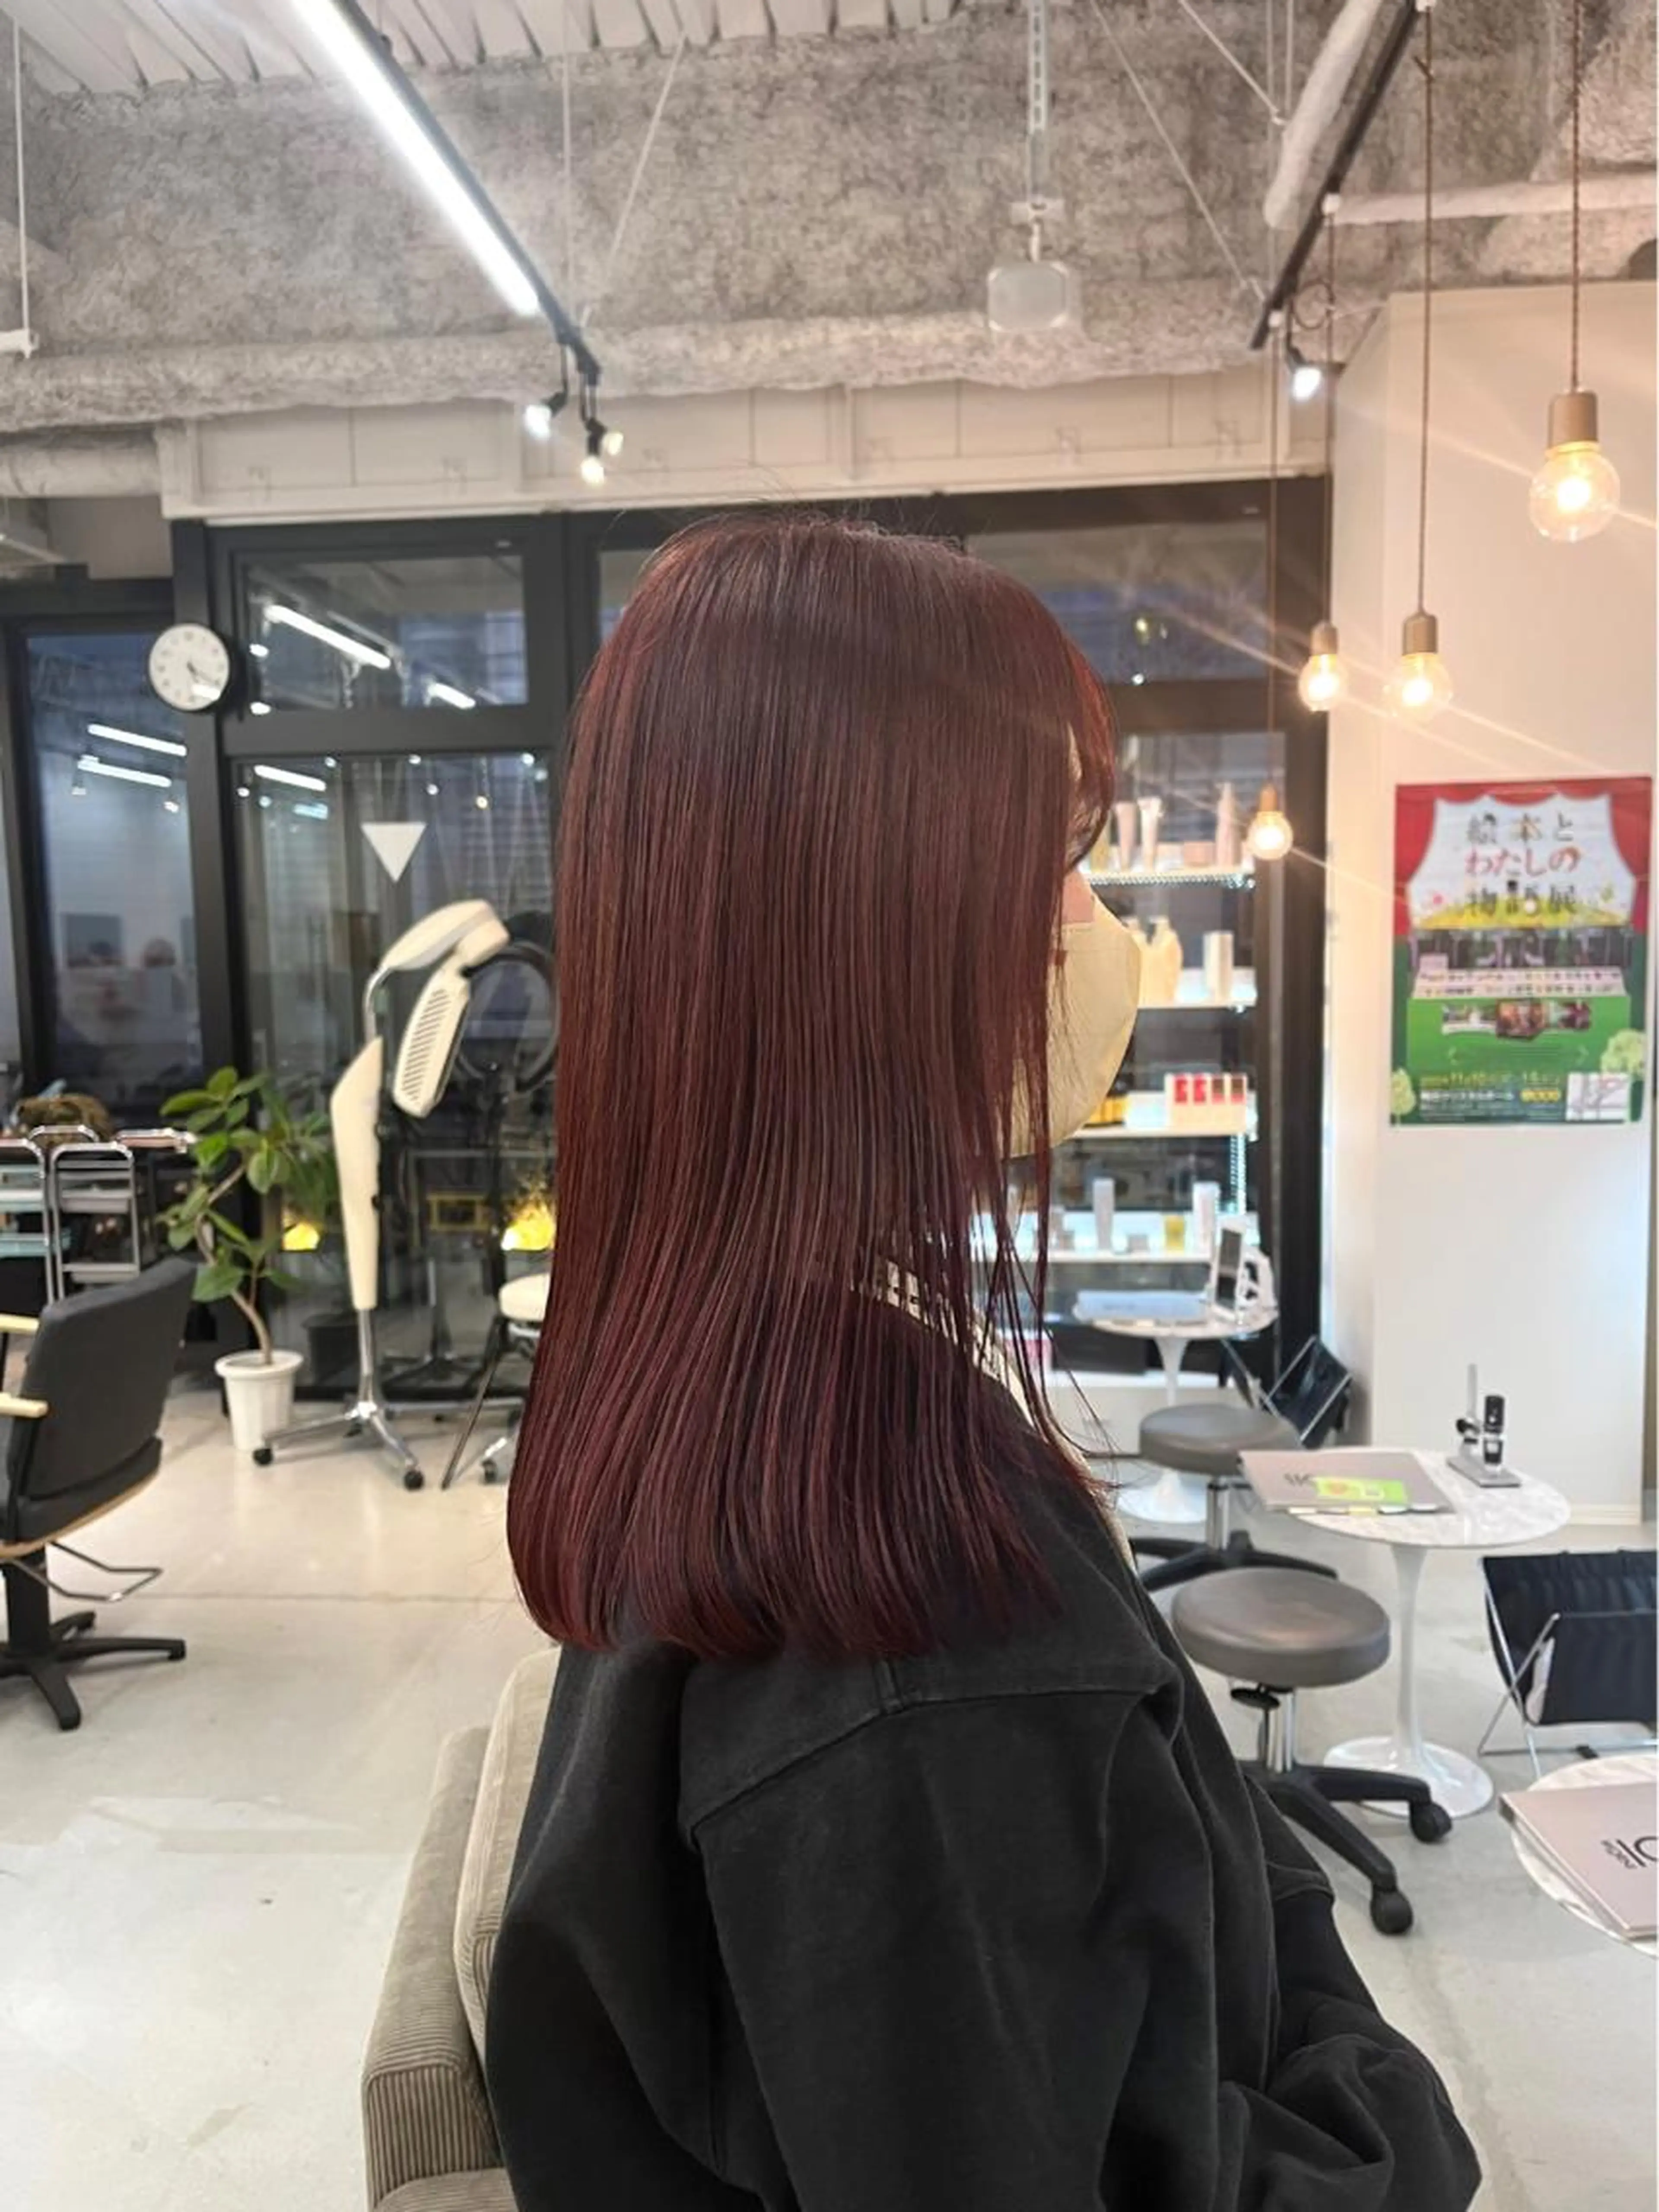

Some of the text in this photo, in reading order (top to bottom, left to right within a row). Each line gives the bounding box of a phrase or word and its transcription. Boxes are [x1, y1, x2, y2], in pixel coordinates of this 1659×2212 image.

[1466, 810, 1574, 845] 絵本と
[1465, 845, 1582, 877] わたしの
